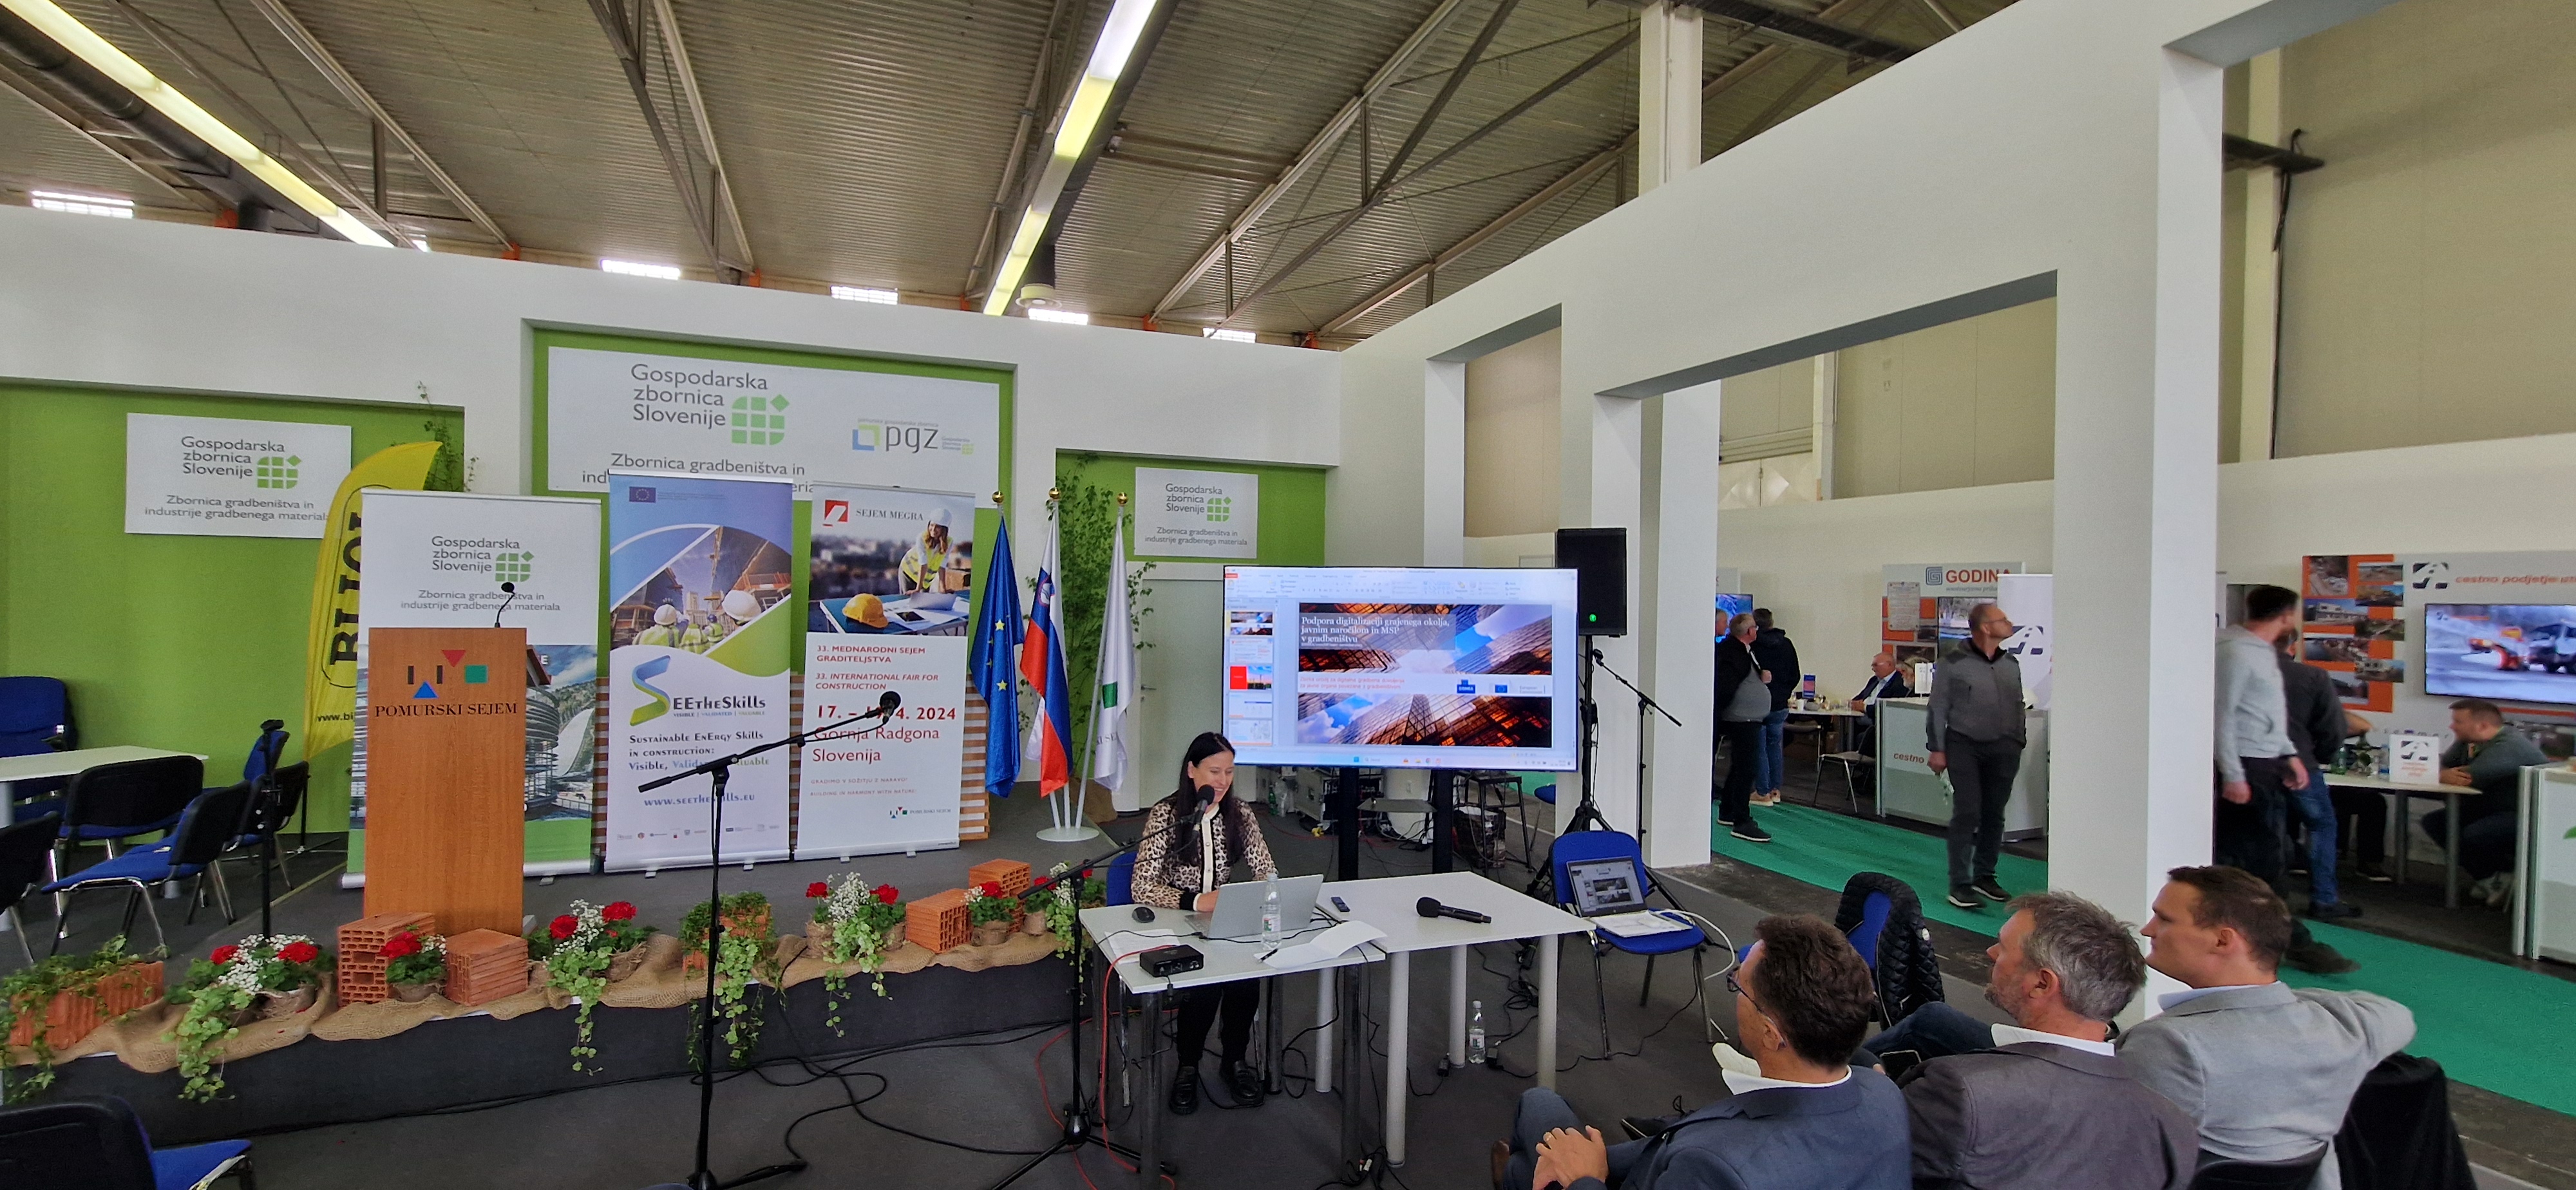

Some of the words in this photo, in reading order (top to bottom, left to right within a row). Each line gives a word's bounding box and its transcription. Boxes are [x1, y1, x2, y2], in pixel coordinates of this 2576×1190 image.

[631, 363, 768, 390] Gospodarska
[634, 385, 724, 406] zbornica
[633, 404, 726, 430] Slovenije
[182, 436, 285, 452] Gospodarska
[886, 426, 938, 453] pgz
[184, 451, 251, 464] zbornica
[611, 453, 685, 469] Zbornica
[690, 458, 787, 475] gradbeništva
[792, 464, 805, 475] in
[183, 463, 252, 478] Slovenije
[1166, 484, 1222, 495] Gospodarska
[167, 495, 222, 506] Zbornica
[225, 498, 299, 509] gradbeništva
[1166, 494, 1204, 503] zbornica
[145, 507, 202, 519] industrije
[206, 509, 274, 521] gradbenega
[857, 509, 886, 518] SEJEM
[891, 511, 923, 520] MEGRA
[1166, 503, 1205, 515] Slovenije
[432, 536, 520, 549] Gospodarska
[1145, 536, 1176, 544] industrije
[1178, 537, 1216, 545] gradbenega
[433, 549, 491, 560] zbornica
[432, 560, 492, 573] Slovenije
[419, 590, 466, 599] Zbornica
[469, 591, 533, 601] gradbenštva
[401, 601, 449, 610] industrije
[453, 603, 511, 612] gradbenega
[1302, 616, 1334, 625] Podpora
[1336, 616, 1383, 626] digitalizaciji
[1385, 618, 1422, 627] grajenega
[1424, 618, 1450, 627] okolja,
[1301, 626, 1328, 635] javnim
[1331, 625, 1369, 634] naročilom
[1308, 634, 1358, 644] gradbeništvu
[817, 655, 891, 664] GRADITELJSTVA
[375, 703, 462, 717] POMURSKI
[468, 703, 517, 715] SEJEM
[818, 705, 842, 718] 17.
[896, 707, 909, 720] 4.
[916, 707, 956, 720] 2024
[736, 731, 763, 740] Skills
[814, 727, 869, 742] Gornja
[876, 726, 940, 742] Radgona
[813, 748, 881, 764] Slovenija
[1894, 753, 1924, 763] cestno
[629, 761, 668, 770] Visible,
